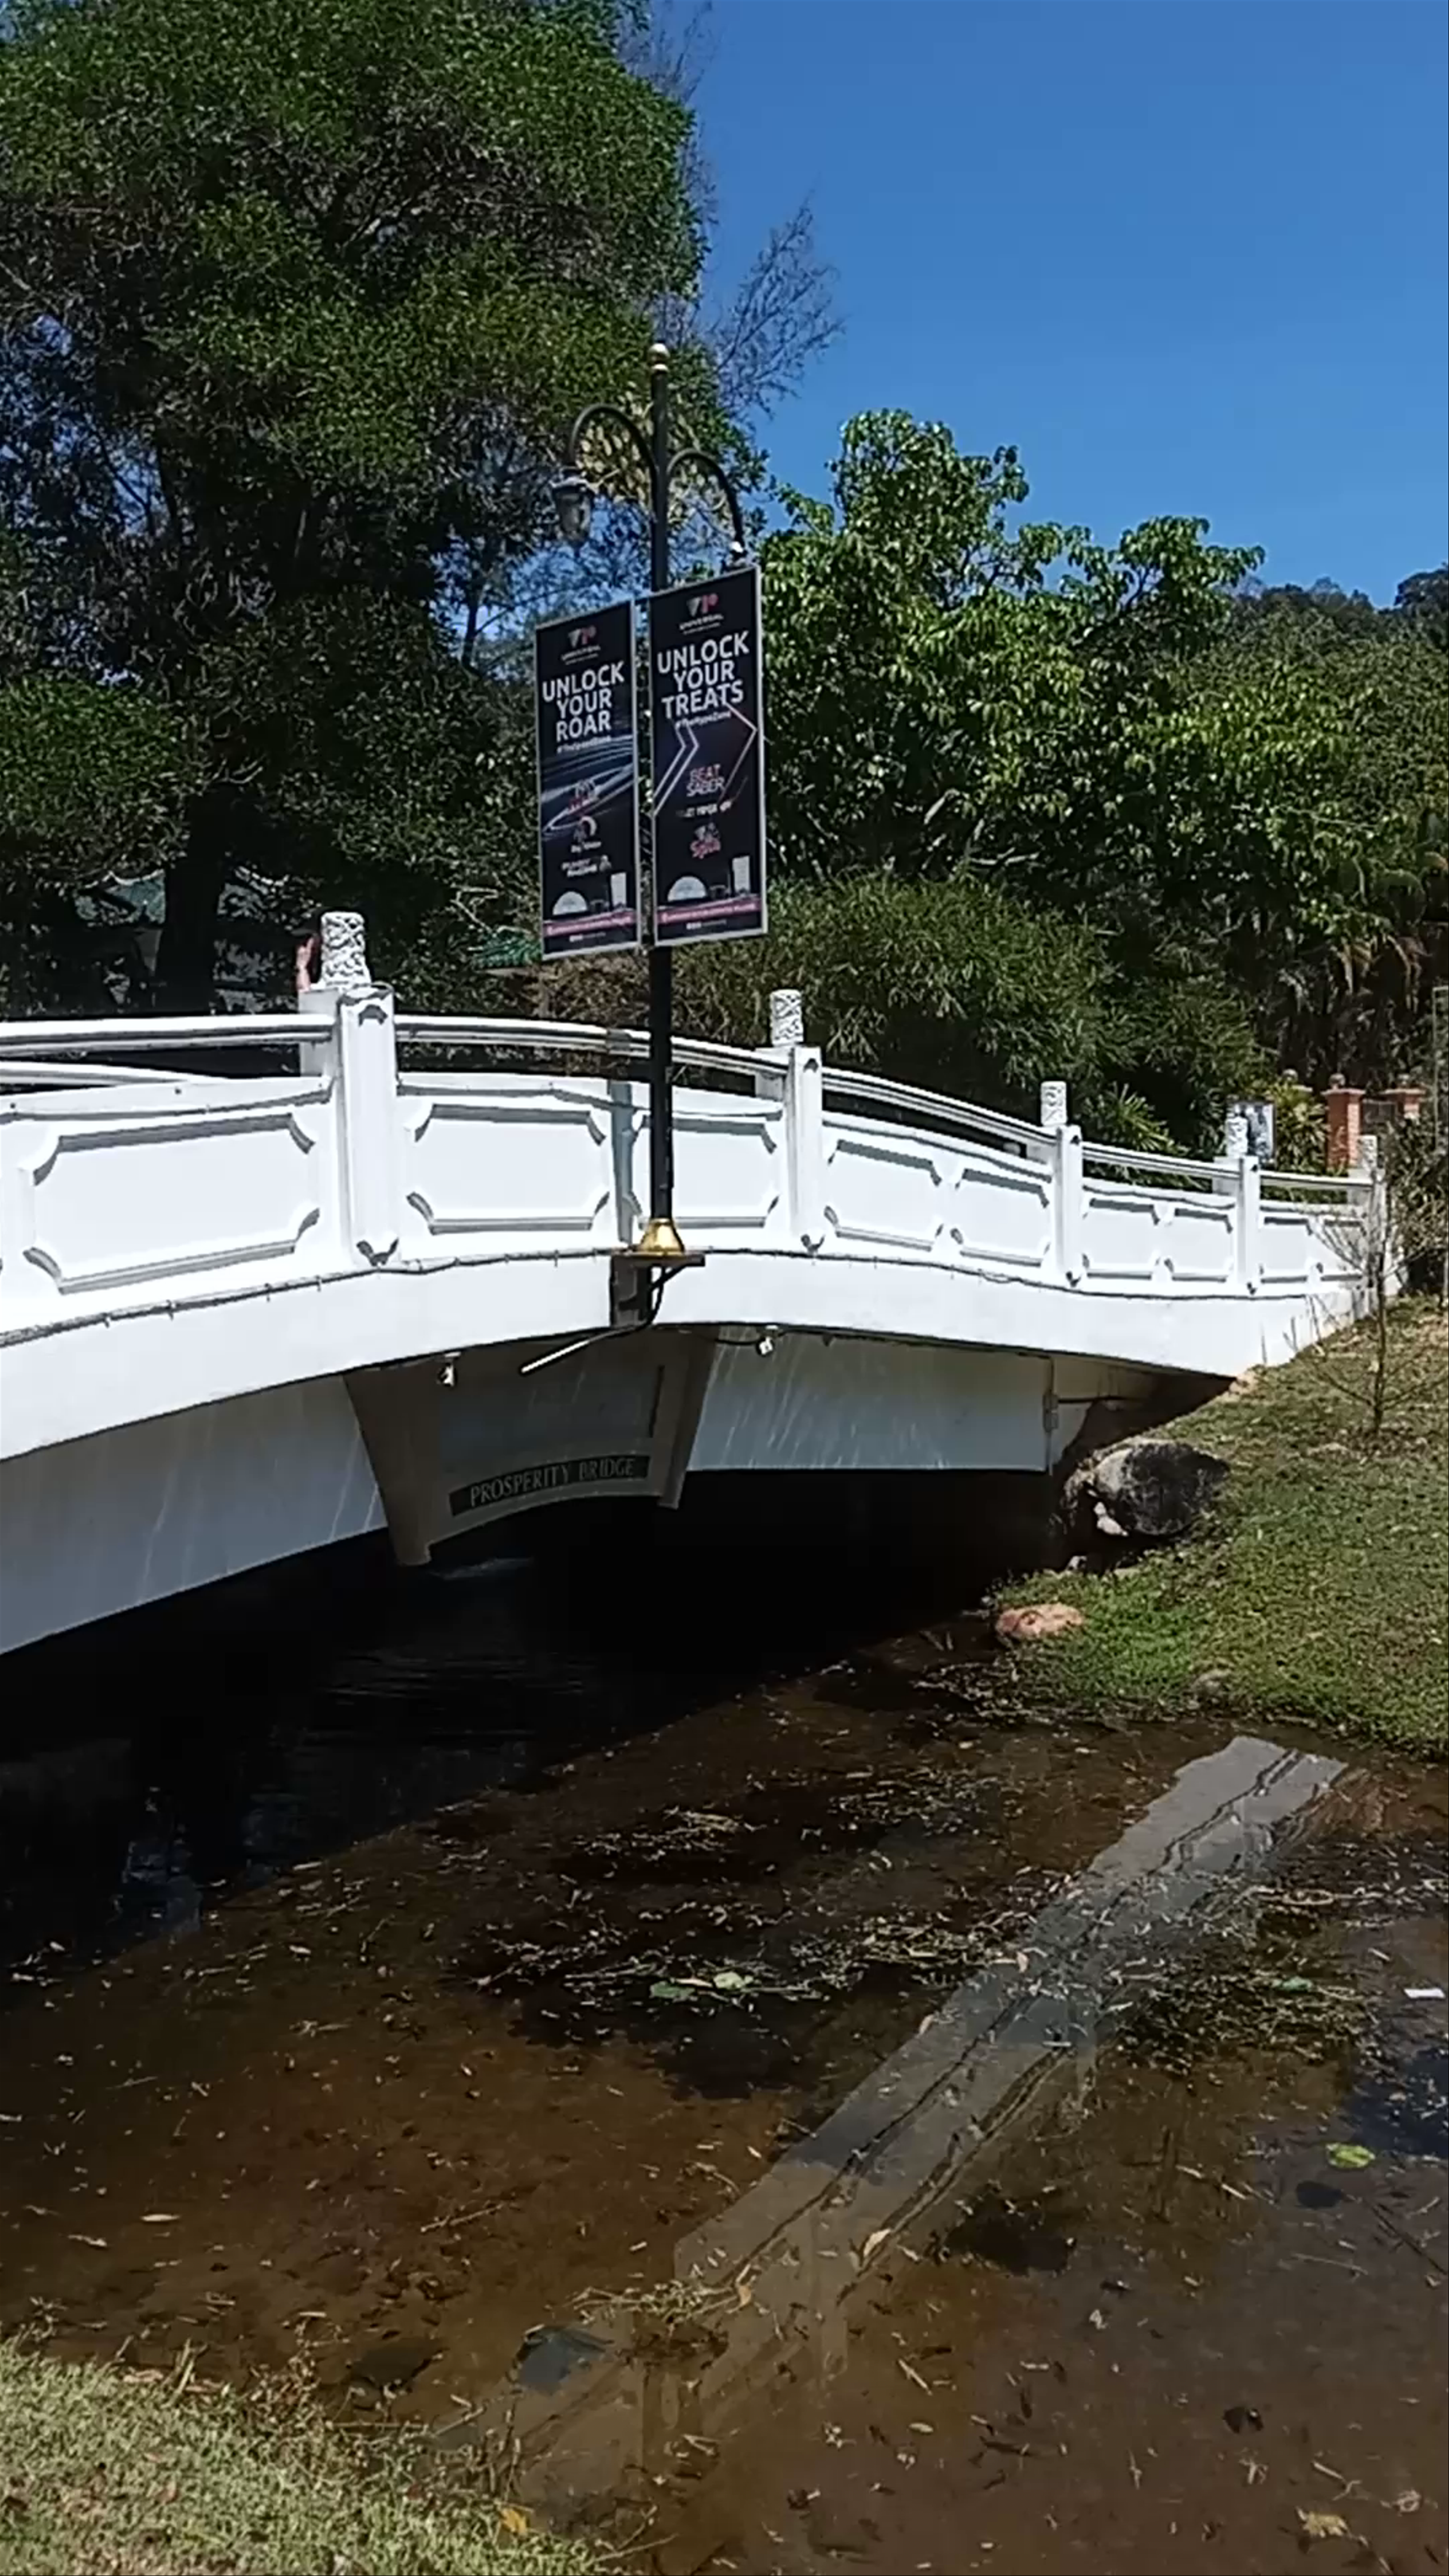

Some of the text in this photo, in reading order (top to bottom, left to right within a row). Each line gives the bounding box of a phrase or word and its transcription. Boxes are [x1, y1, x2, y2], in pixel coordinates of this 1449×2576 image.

[657, 631, 750, 674] UNLOCK
[542, 661, 625, 703] UNLOCK
[674, 660, 735, 693] YOUR
[557, 688, 612, 720] YOUR
[661, 680, 744, 720] TREATS
[556, 709, 612, 743] ROAR
[470, 1457, 636, 1507] PROSPERITY BRIDGE
